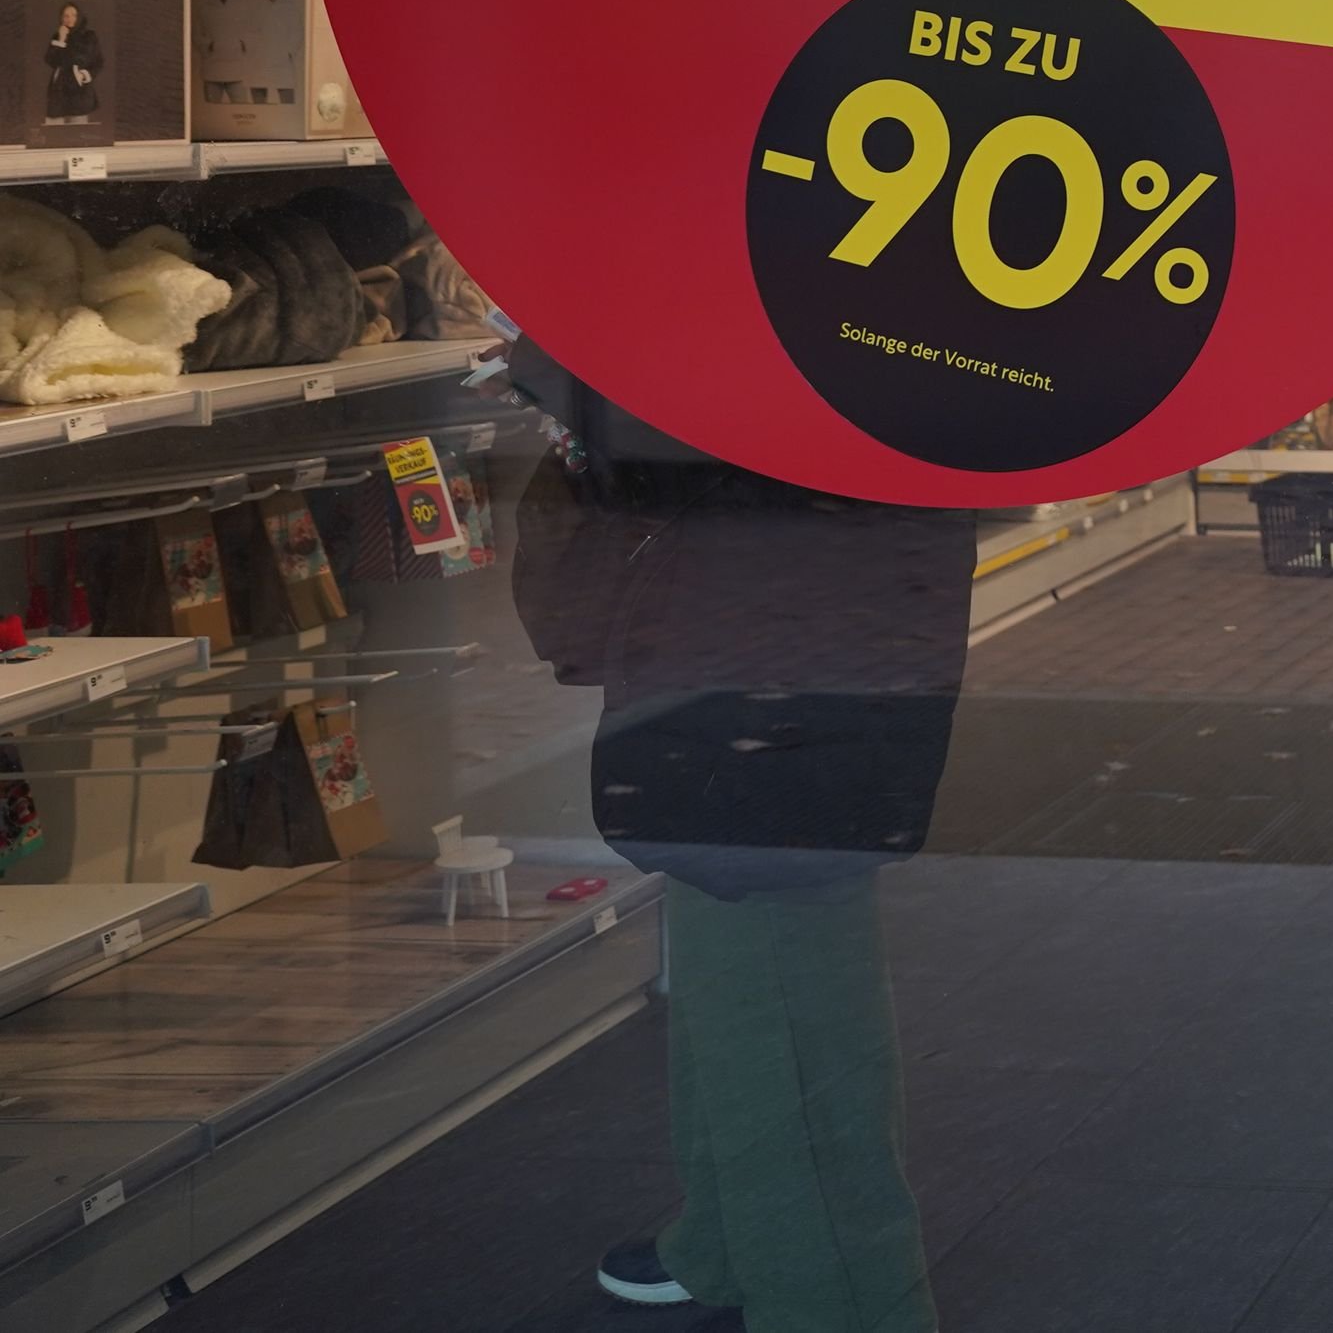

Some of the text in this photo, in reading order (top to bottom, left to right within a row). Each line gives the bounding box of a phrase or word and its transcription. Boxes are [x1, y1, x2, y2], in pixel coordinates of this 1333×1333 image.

[908, 10, 1081, 81] BIS ZU
[762, 79, 1218, 310] -90%
[840, 322, 1055, 392] Solange der Vorrat reicht.
